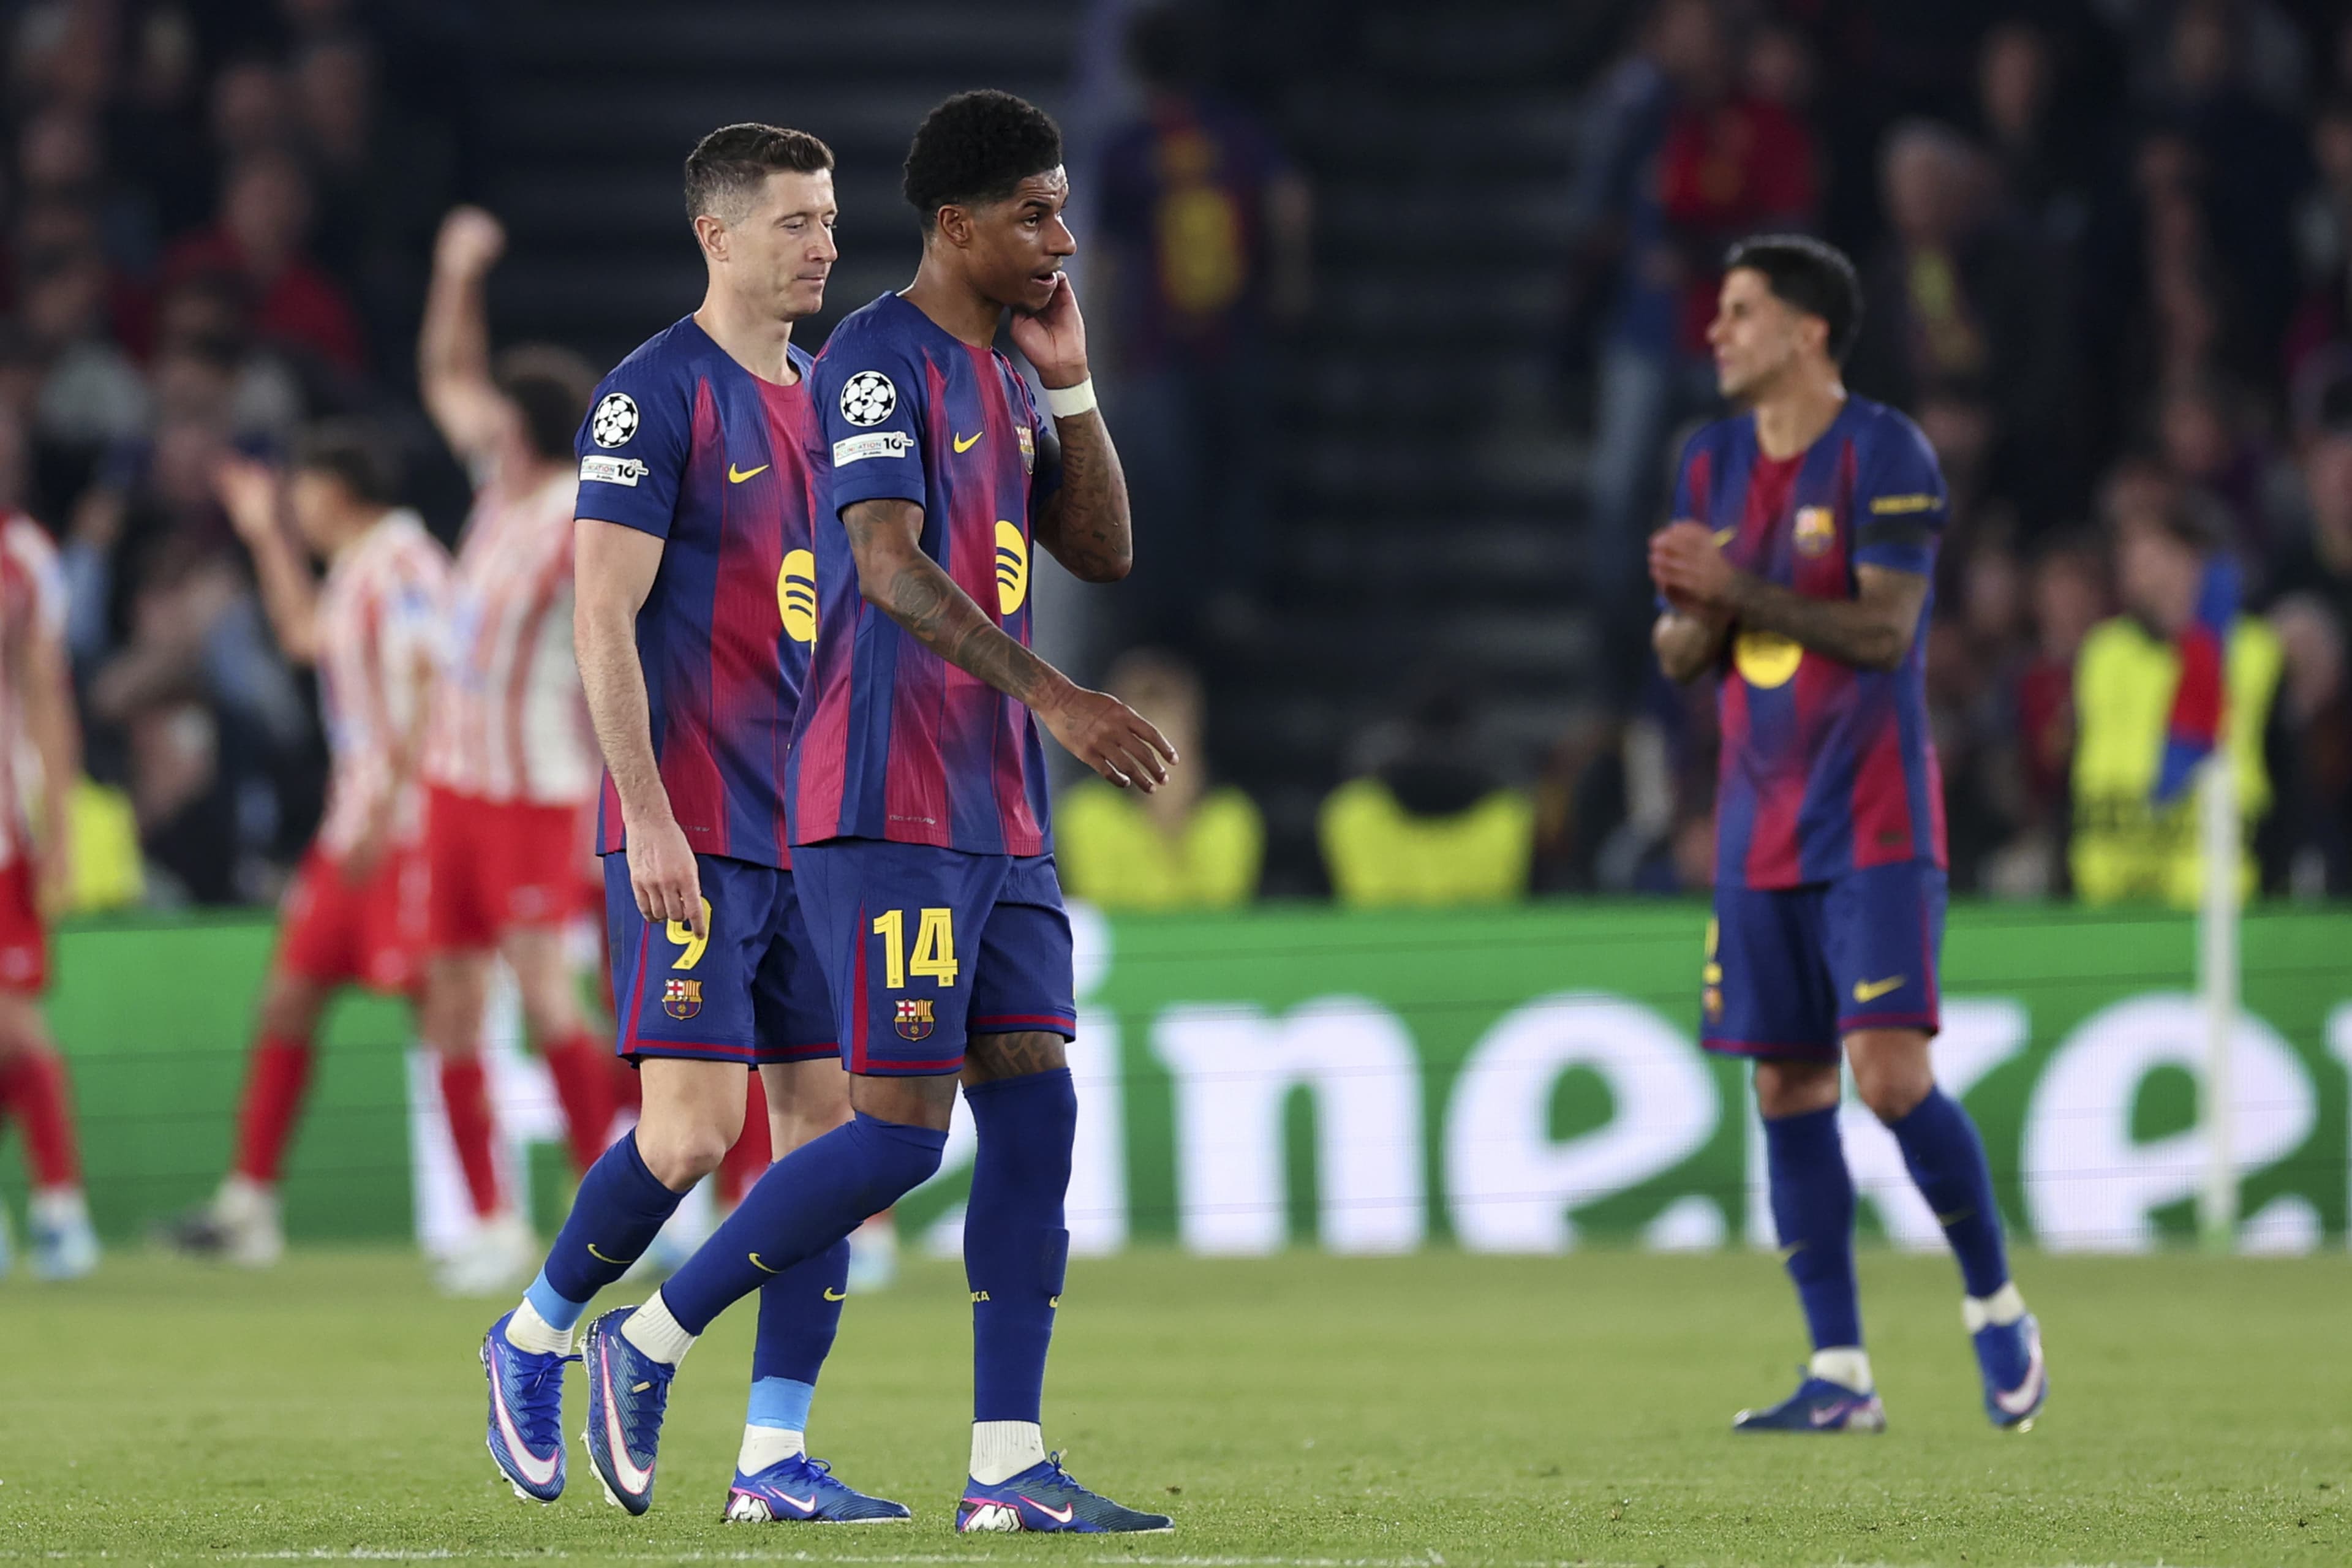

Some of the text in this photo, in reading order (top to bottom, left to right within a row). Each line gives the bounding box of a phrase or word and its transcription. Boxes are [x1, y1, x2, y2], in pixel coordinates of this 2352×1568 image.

[883, 437, 903, 450] 10
[616, 464, 636, 478] 10
[666, 897, 712, 970] 9
[873, 908, 958, 989] 14
